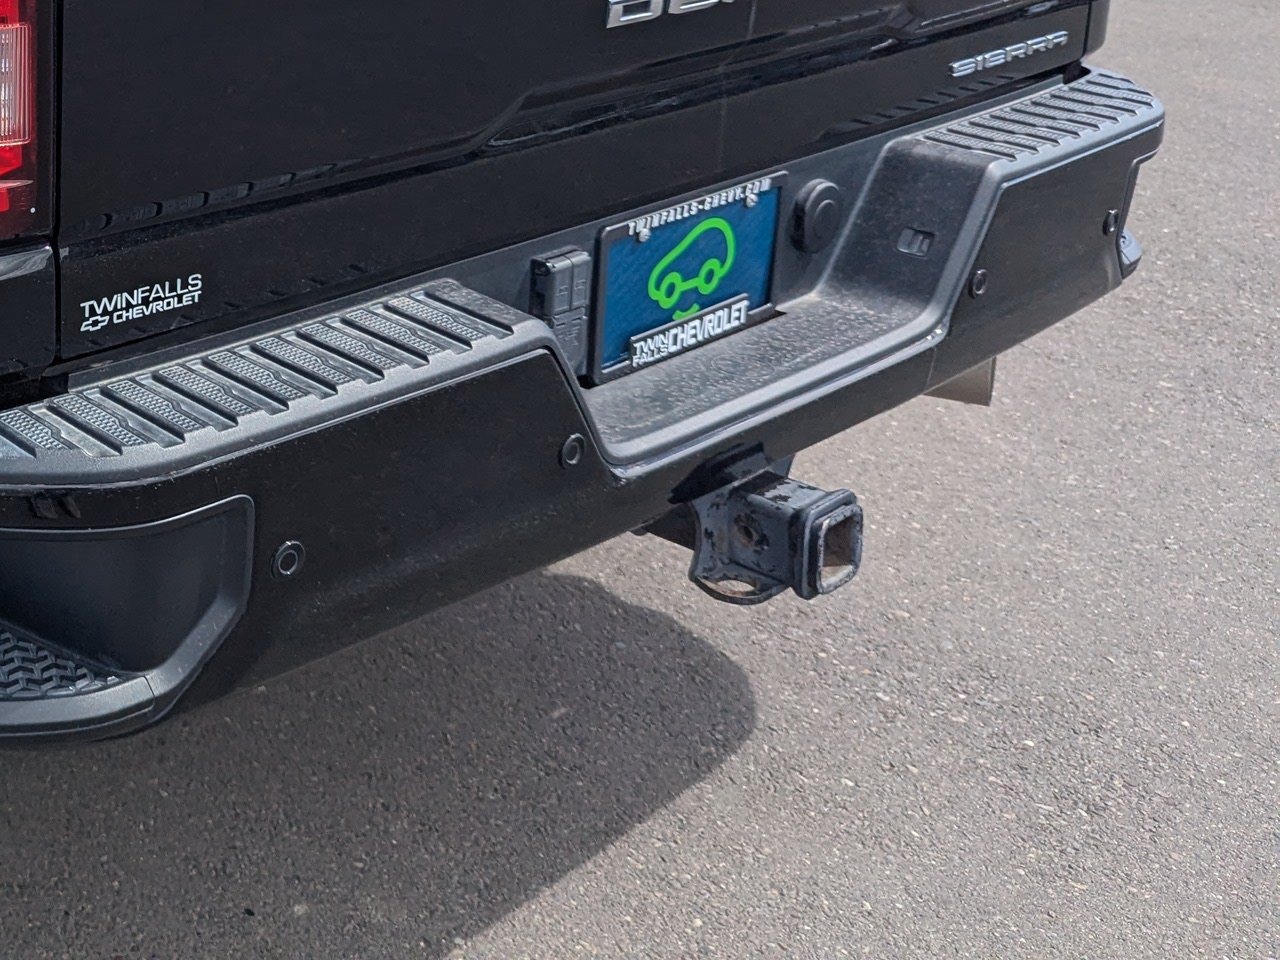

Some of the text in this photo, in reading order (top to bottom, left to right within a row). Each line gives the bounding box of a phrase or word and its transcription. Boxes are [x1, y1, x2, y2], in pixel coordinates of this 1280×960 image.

[947, 30, 1069, 78] SIERRA
[113, 291, 203, 324] CHEVROLET
[668, 299, 750, 353] CHEVROLET
[632, 346, 669, 368] FALLS
[633, 331, 669, 356] TWIN
